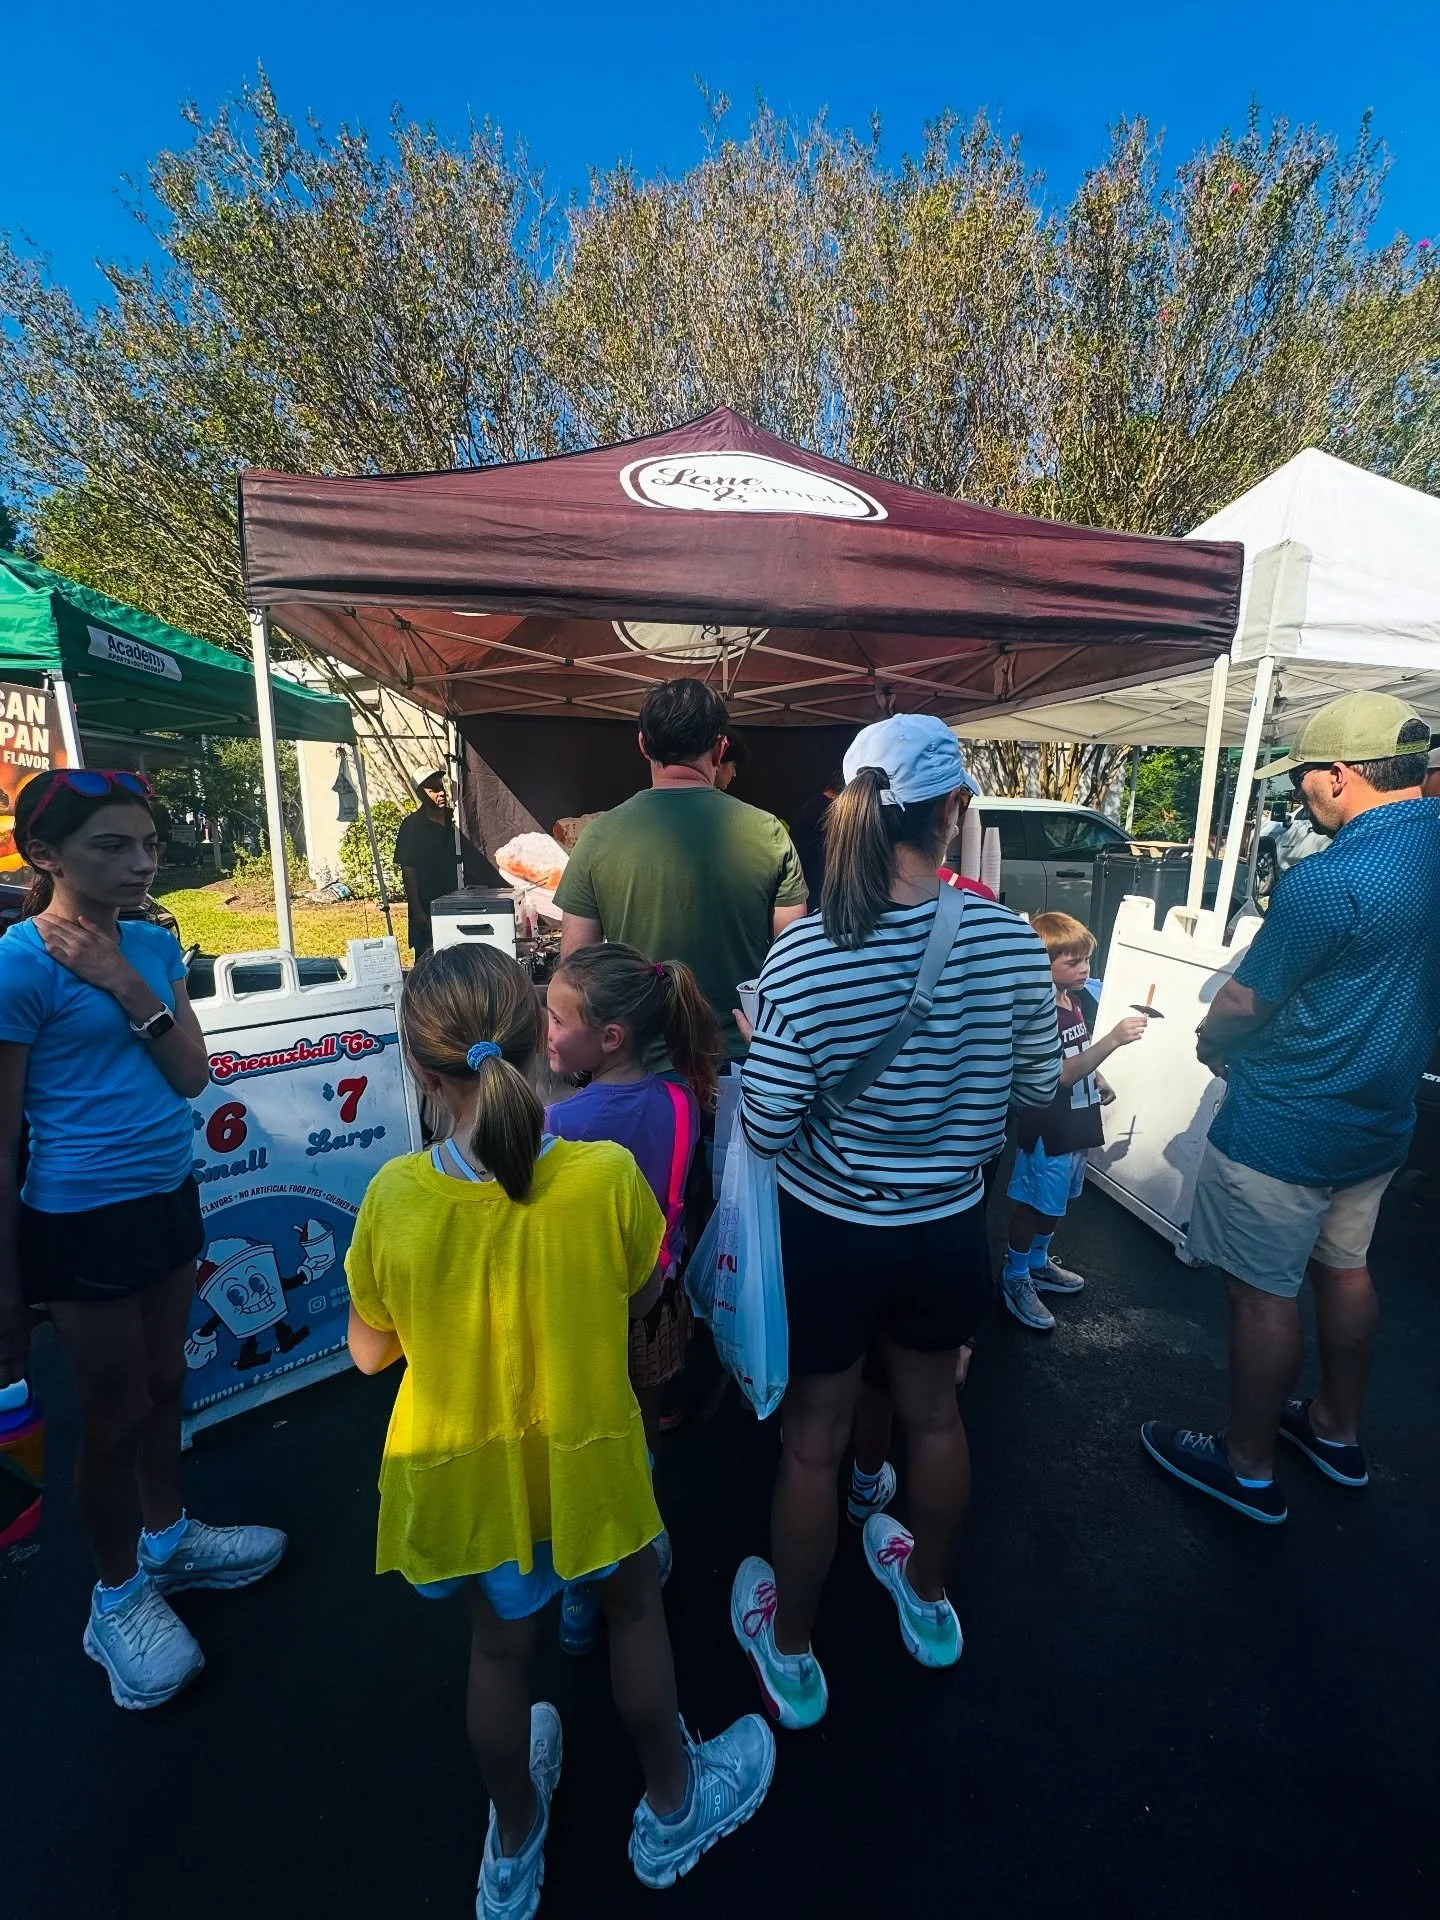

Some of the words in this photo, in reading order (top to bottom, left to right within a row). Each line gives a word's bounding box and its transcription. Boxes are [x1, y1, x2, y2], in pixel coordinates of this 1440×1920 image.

[651, 467, 763, 493] Lane
[108, 634, 166, 673] Academy
[4, 749, 50, 771] FLAVOR
[209, 1037, 337, 1079] Sneauxball
[340, 1032, 379, 1055] Co.
[322, 1075, 368, 1124] $7
[305, 1125, 386, 1157] Large
[191, 1147, 270, 1185] Small
[200, 1195, 234, 1214] FLAVORS
[238, 1189, 249, 1200] NO
[250, 1184, 288, 1197] ARTIFICIAL
[288, 1184, 306, 1194] FOOD
[306, 1186, 323, 1198] DYES
[325, 1193, 350, 1210] COLORED
